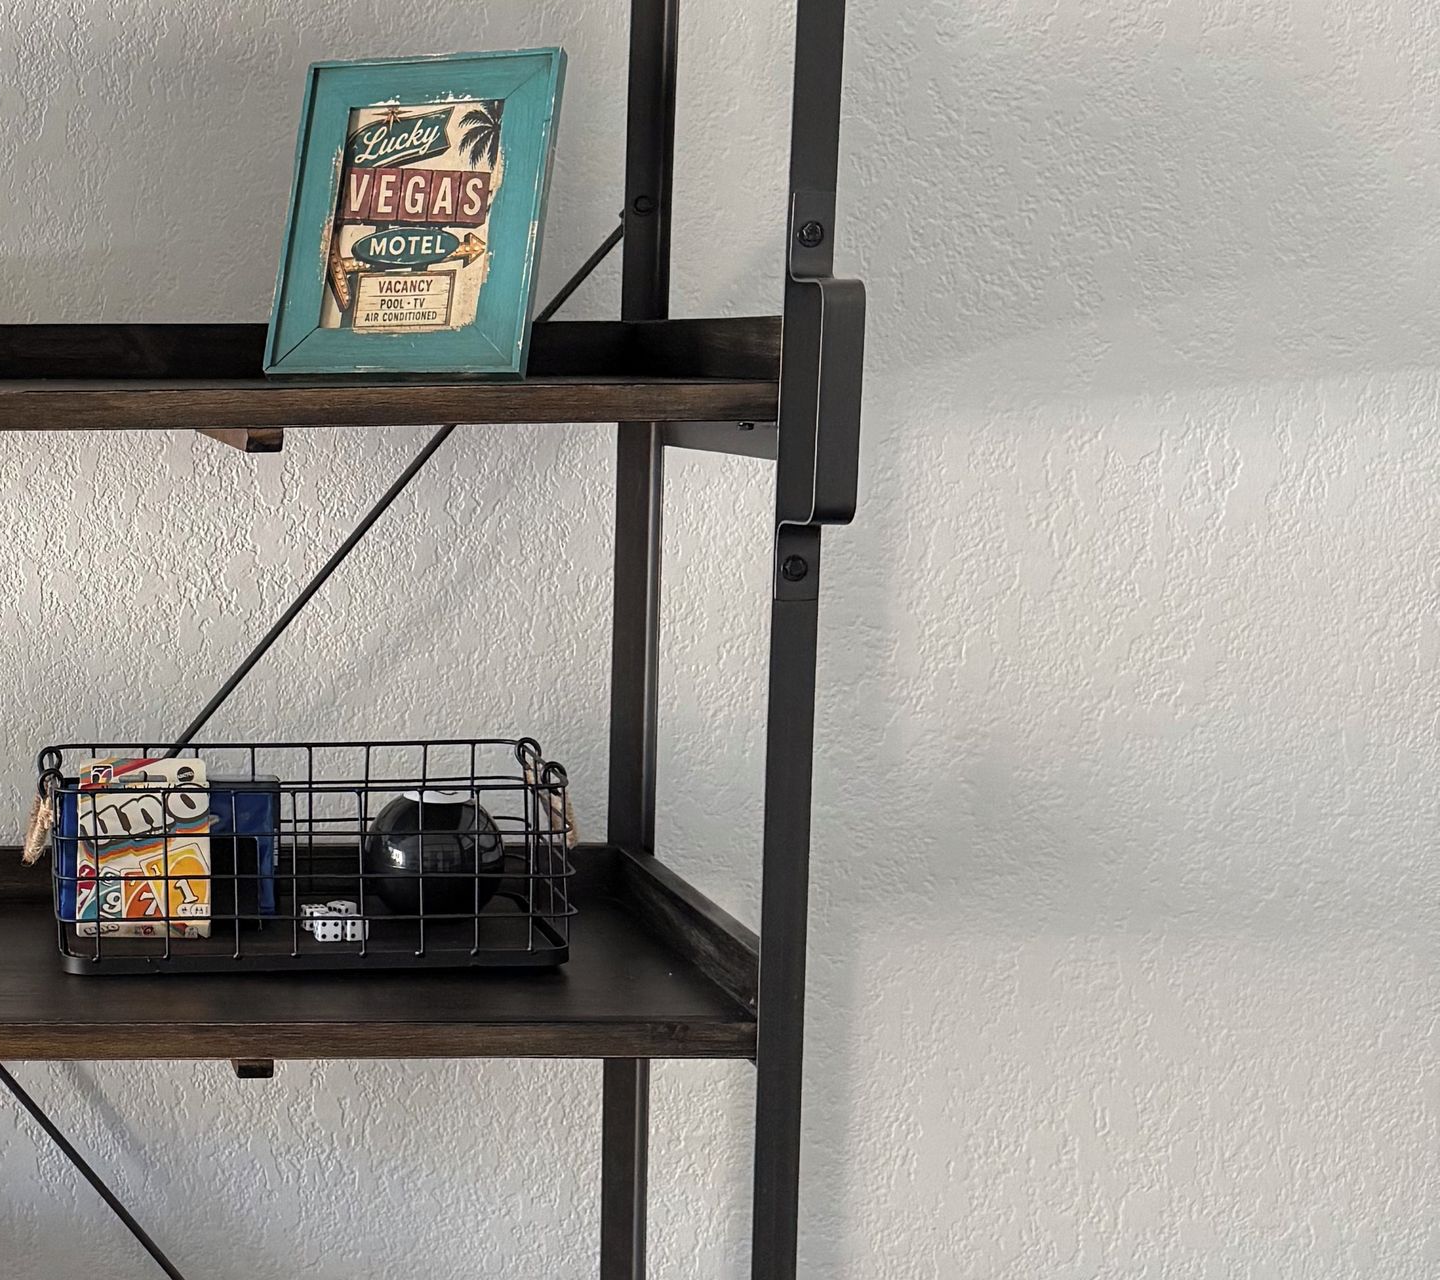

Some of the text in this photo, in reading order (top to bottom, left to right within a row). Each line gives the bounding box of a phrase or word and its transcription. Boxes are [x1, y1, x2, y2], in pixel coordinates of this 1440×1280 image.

[355, 119, 440, 163] Lucky
[350, 173, 483, 216] VEGAS
[369, 235, 445, 256] MOTEL
[378, 279, 433, 294] VACANCY
[380, 297, 426, 309] POOL TV
[365, 310, 437, 322] AIR CONDITIONED
